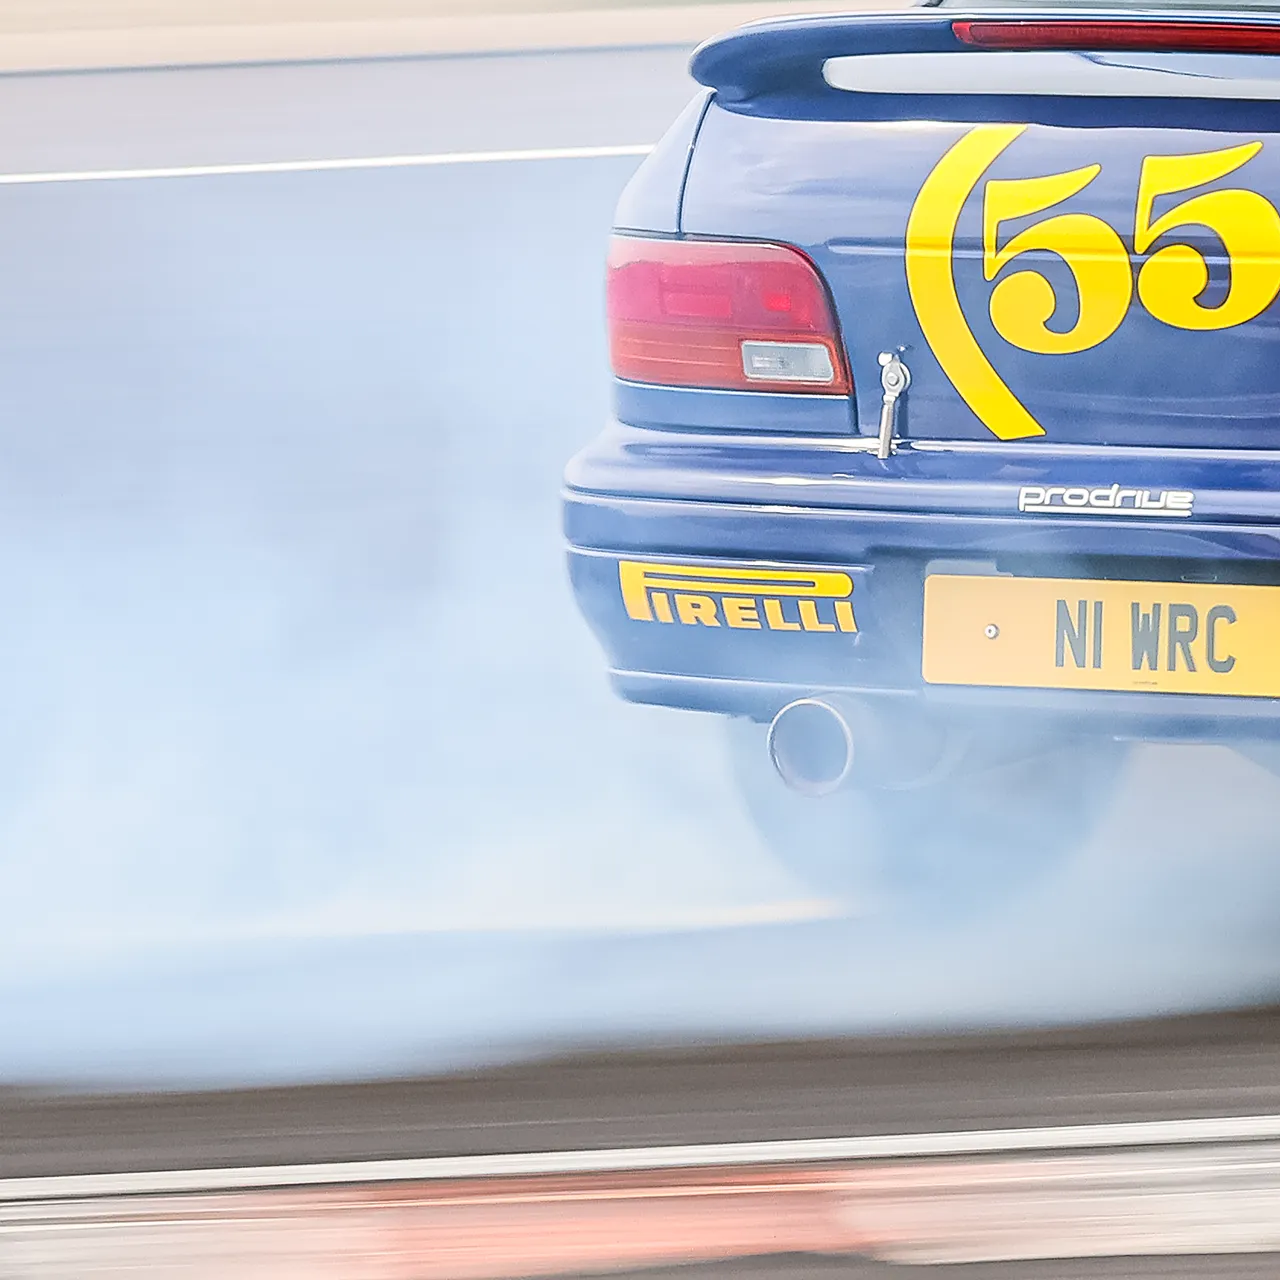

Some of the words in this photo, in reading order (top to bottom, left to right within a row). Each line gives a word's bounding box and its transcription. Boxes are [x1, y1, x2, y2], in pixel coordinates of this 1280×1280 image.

[1018, 483, 1196, 516] prodrive
[618, 560, 859, 634] PIRELLI
[1055, 598, 1103, 670] N1
[1130, 601, 1238, 673] WRC
